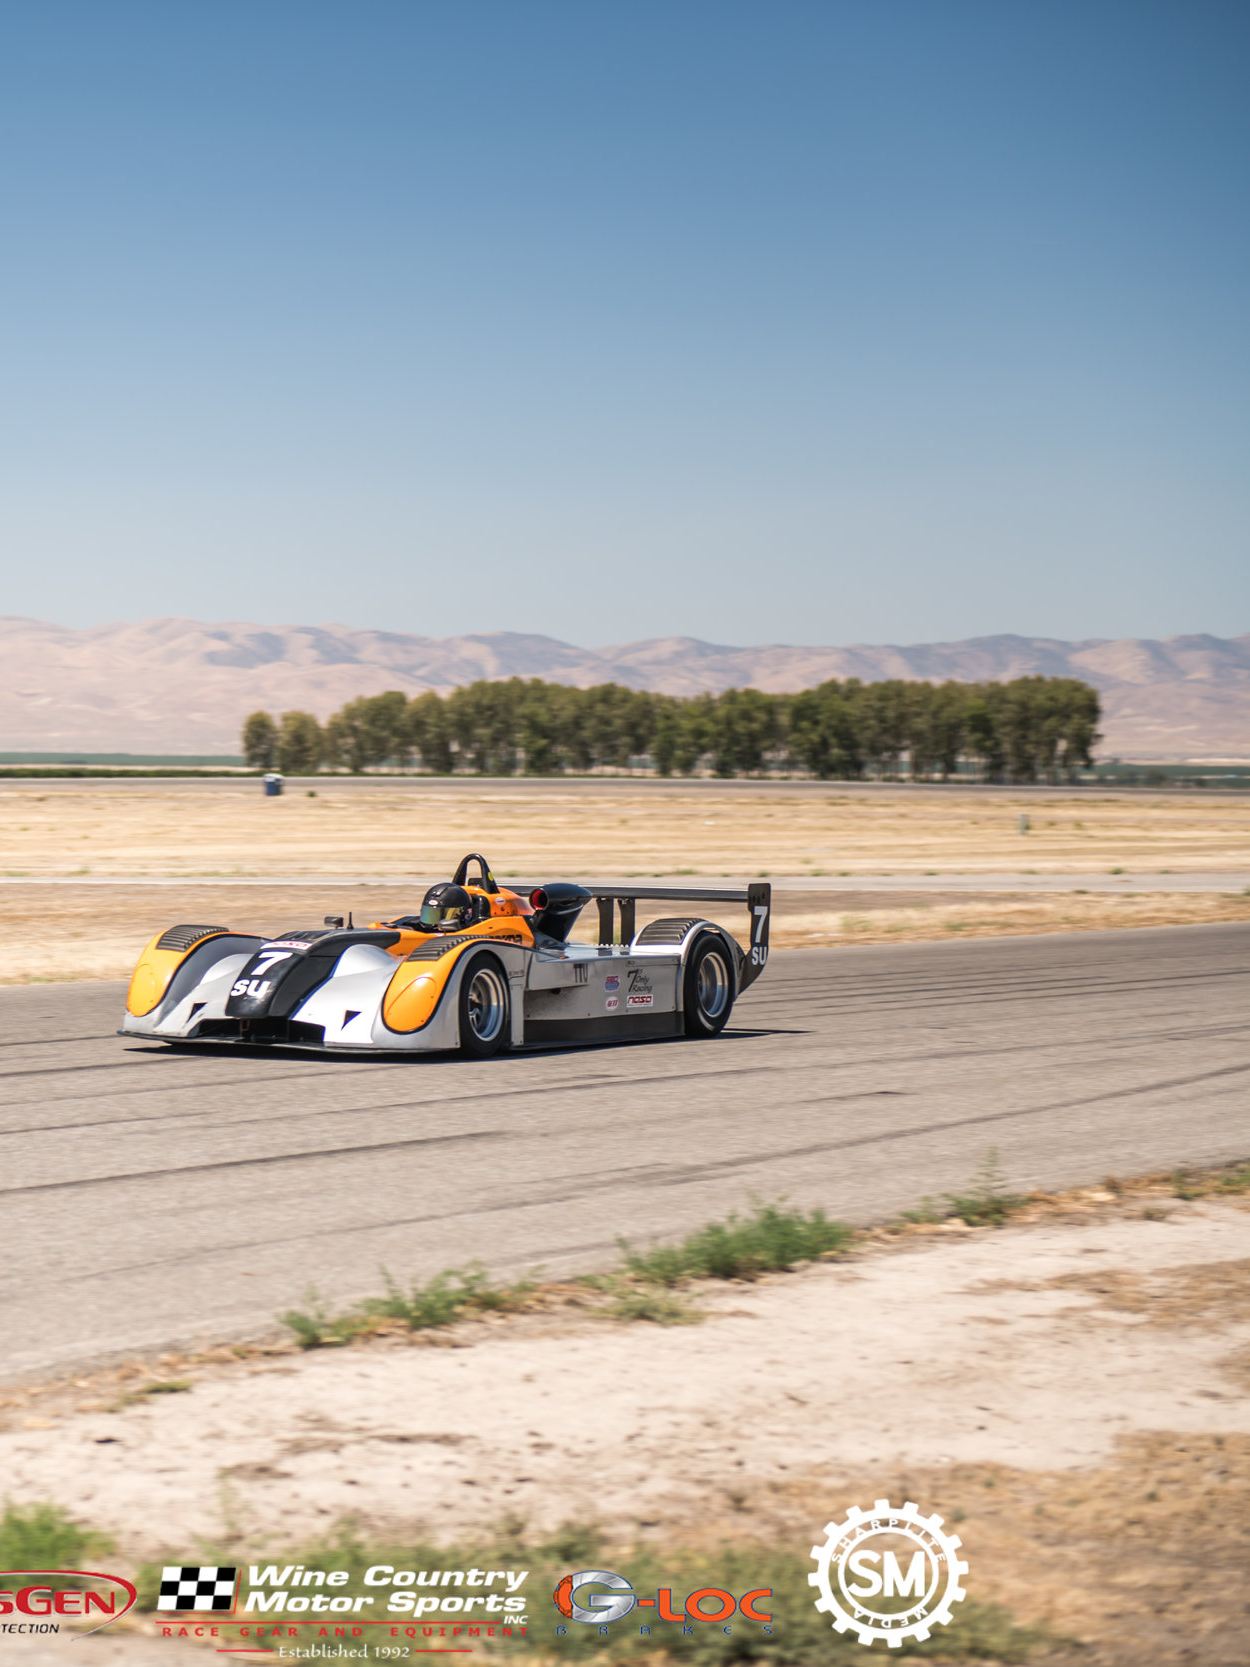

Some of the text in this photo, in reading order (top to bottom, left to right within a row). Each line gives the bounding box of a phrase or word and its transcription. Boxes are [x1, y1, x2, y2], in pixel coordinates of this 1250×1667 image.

[753, 905, 768, 943] 7
[250, 951, 294, 976] 7
[751, 945, 767, 966] SU
[230, 979, 271, 999] SU
[632, 985, 653, 993] Racing
